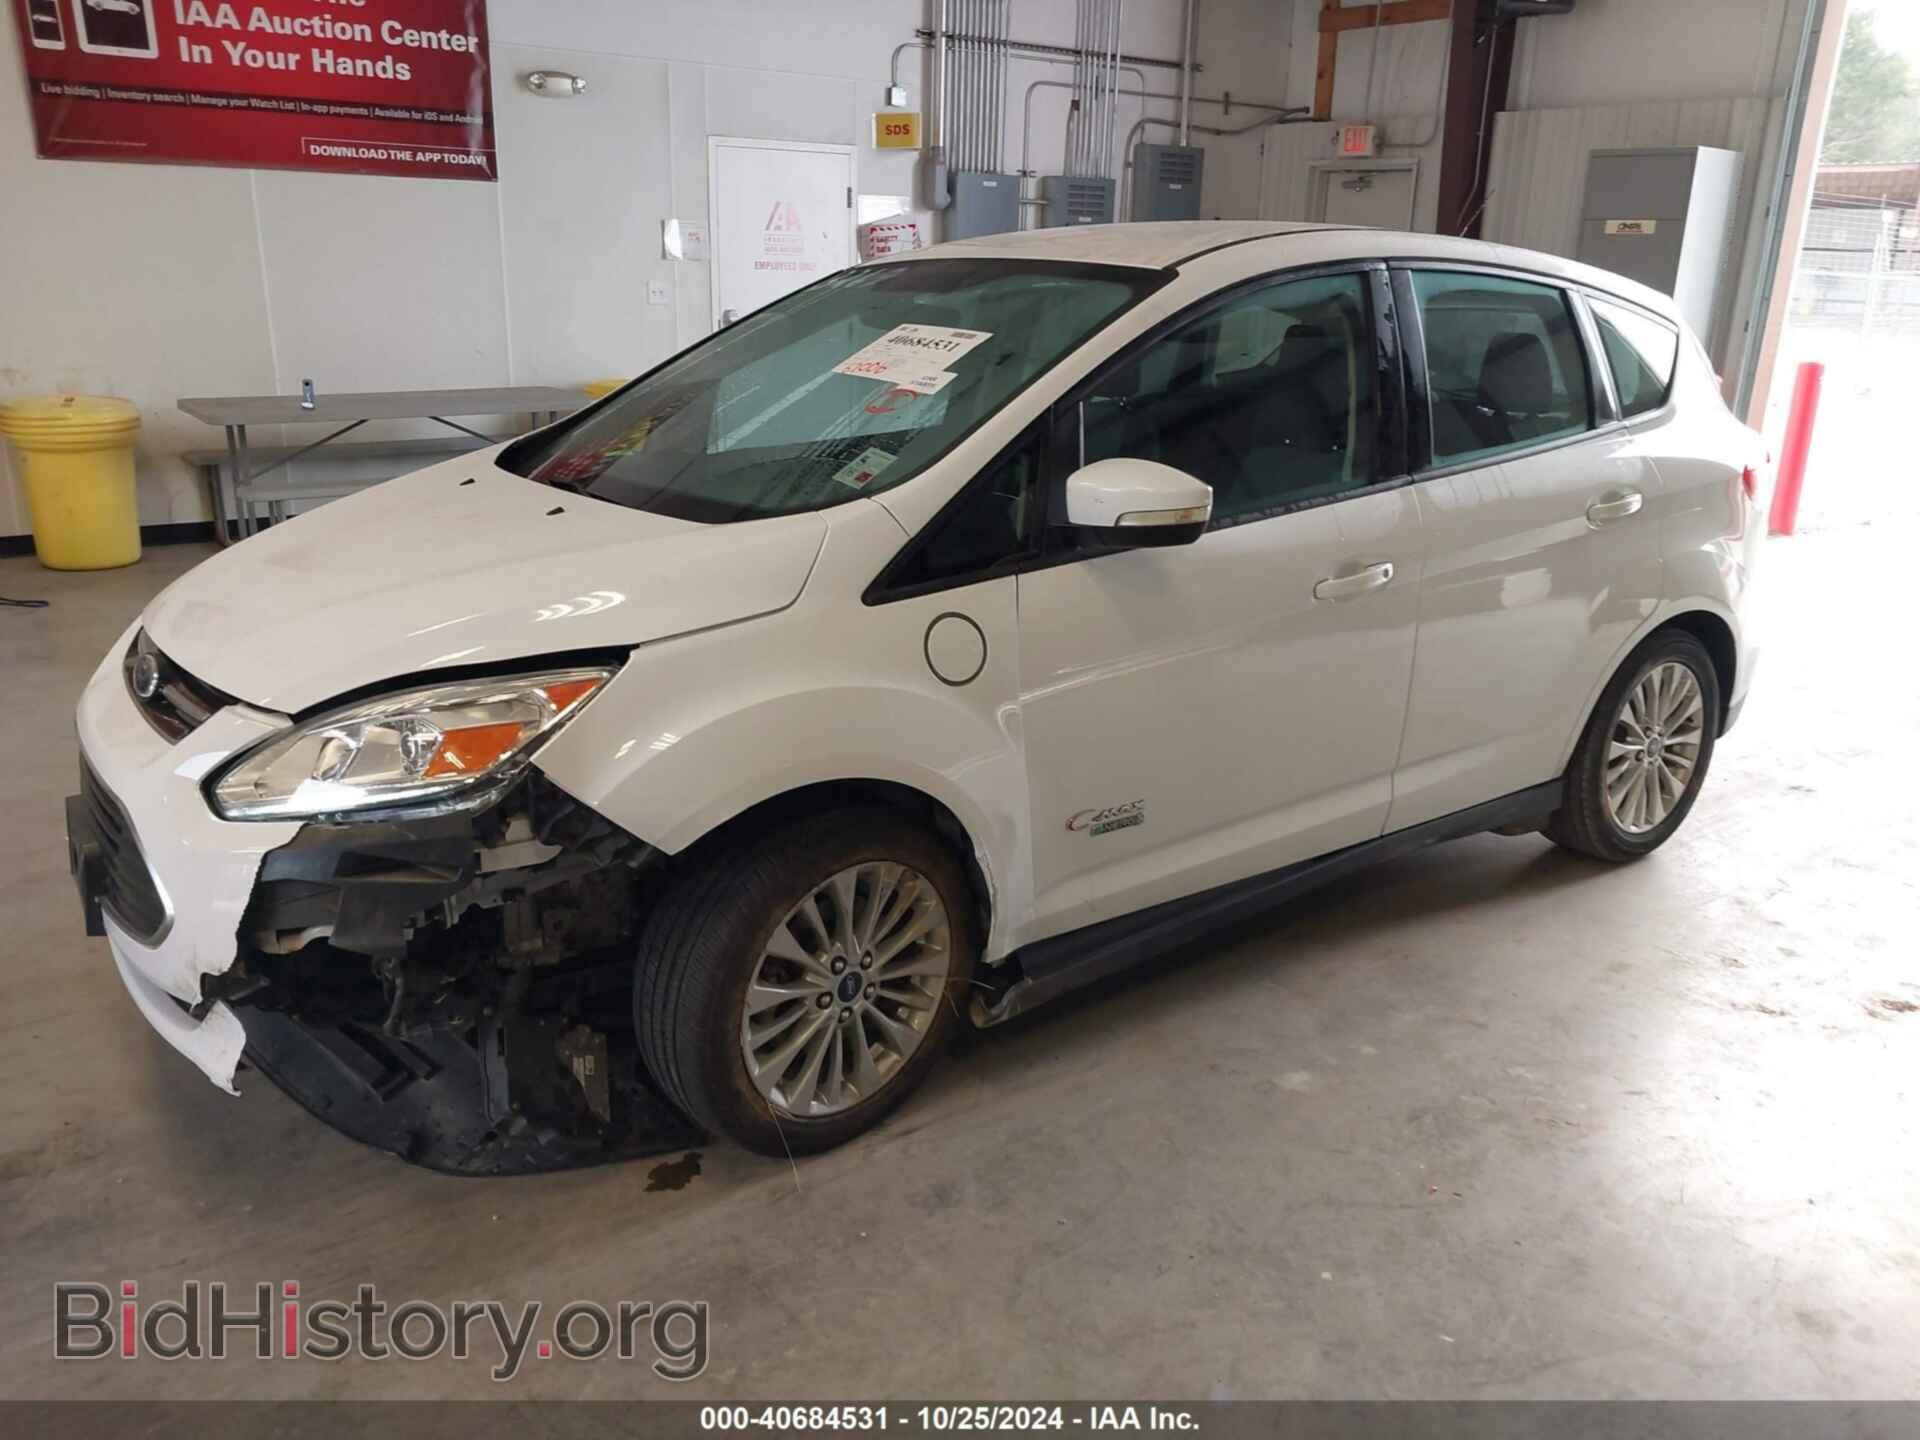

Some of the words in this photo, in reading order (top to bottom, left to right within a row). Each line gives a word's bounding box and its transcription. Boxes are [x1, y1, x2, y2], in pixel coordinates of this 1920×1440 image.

[174, 0, 241, 30] IAA
[248, 7, 373, 42] Auction
[381, 20, 479, 53] Center
[178, 36, 213, 64] In
[221, 40, 301, 70] Your
[312, 48, 412, 81] Hands
[40, 83, 62, 94] Live
[63, 84, 100, 98] bidding
[107, 88, 151, 102] Inventory
[153, 93, 184, 103] search
[191, 94, 228, 107] Manage
[229, 98, 249, 108] your
[250, 98, 279, 109] Watch
[280, 101, 295, 110] List
[329, 105, 369, 116] payments
[374, 108, 410, 119] Available
[411, 110, 423, 120] for
[424, 111, 438, 121] iOS
[440, 113, 453, 122] and
[885, 123, 910, 136] SDS
[309, 144, 388, 160] DOWNLOAD
[389, 149, 412, 162] THE
[415, 151, 442, 163] APP
[443, 153, 487, 165] TODAY!
